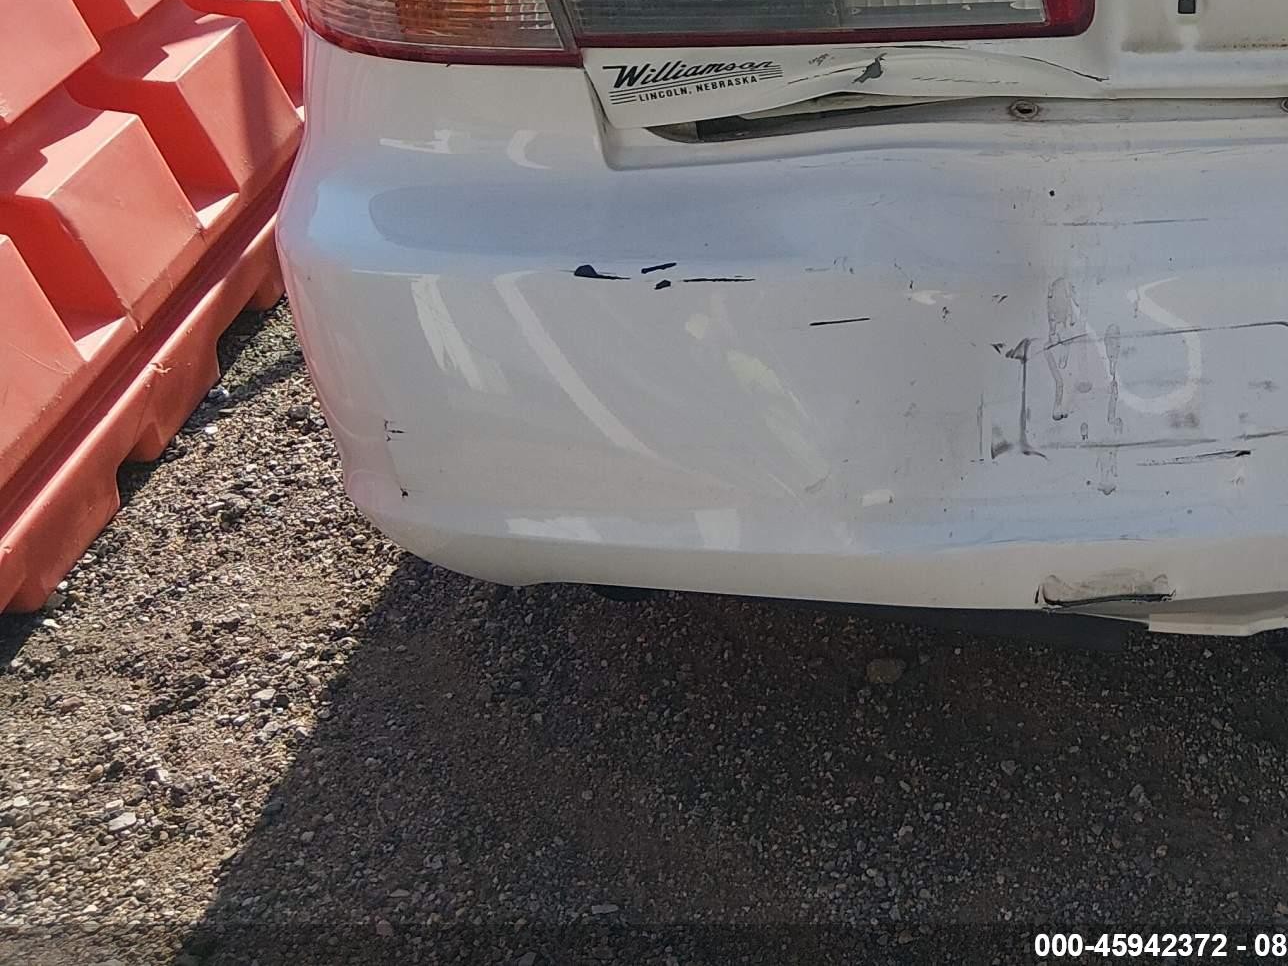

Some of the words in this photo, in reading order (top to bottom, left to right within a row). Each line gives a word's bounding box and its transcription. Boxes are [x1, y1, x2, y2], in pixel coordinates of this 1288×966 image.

[602, 60, 774, 89] Williamson
[638, 87, 693, 102] LINCOLN,
[695, 75, 758, 93] NEBRASKA
